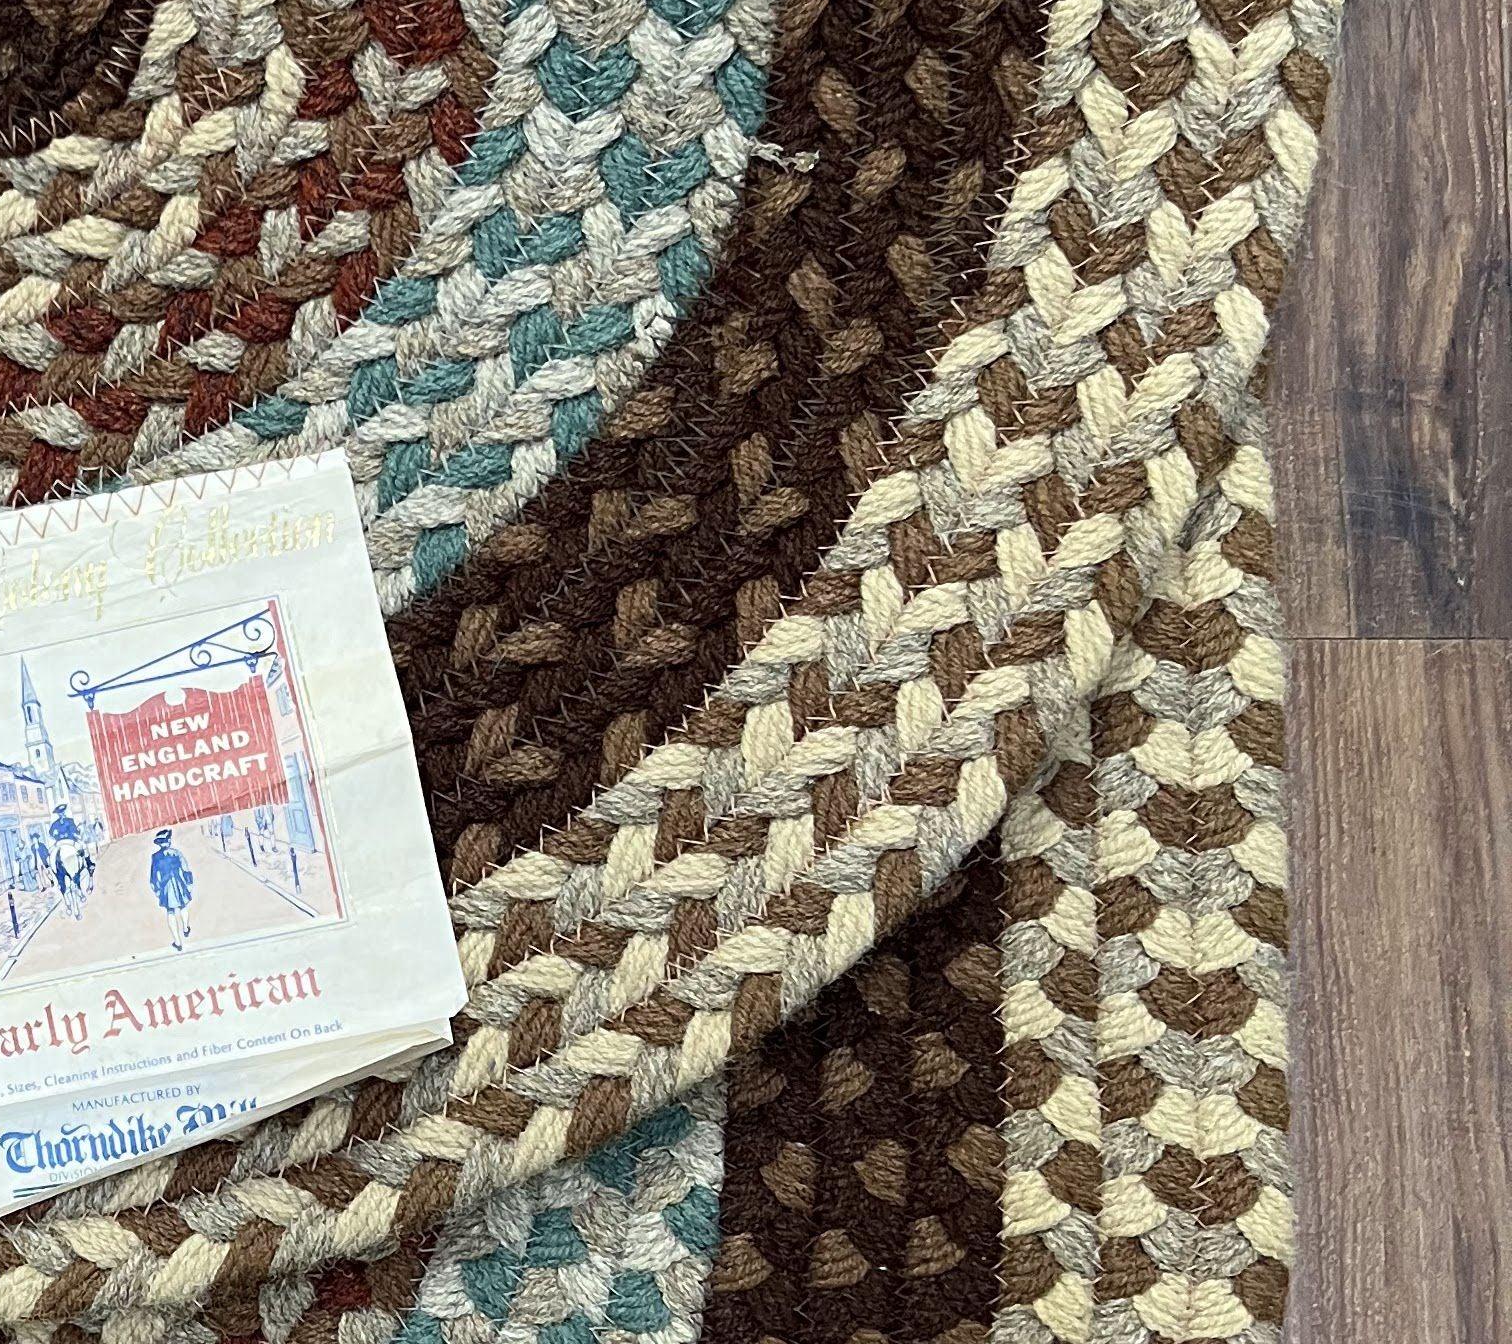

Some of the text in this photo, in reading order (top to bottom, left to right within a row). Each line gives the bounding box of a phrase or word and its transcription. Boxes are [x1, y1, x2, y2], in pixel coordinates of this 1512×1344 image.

[110, 504, 334, 592] Collection
[121, 730, 250, 773] ENGLAND
[150, 712, 210, 740] NEW
[112, 752, 269, 803] HANDCRAFT
[102, 965, 323, 1040] American
[7, 1081, 41, 1096] Sizes,
[44, 1069, 98, 1087] Cleaning
[101, 1055, 173, 1077] Instructions
[176, 1046, 199, 1062] and
[202, 1042, 233, 1057] Fiber
[236, 1032, 287, 1050] Content
[290, 1027, 311, 1040] On
[314, 1019, 344, 1035] Back
[72, 1084, 202, 1113] MANUFACTURED BY
[0, 1112, 172, 1174] Thorndike
